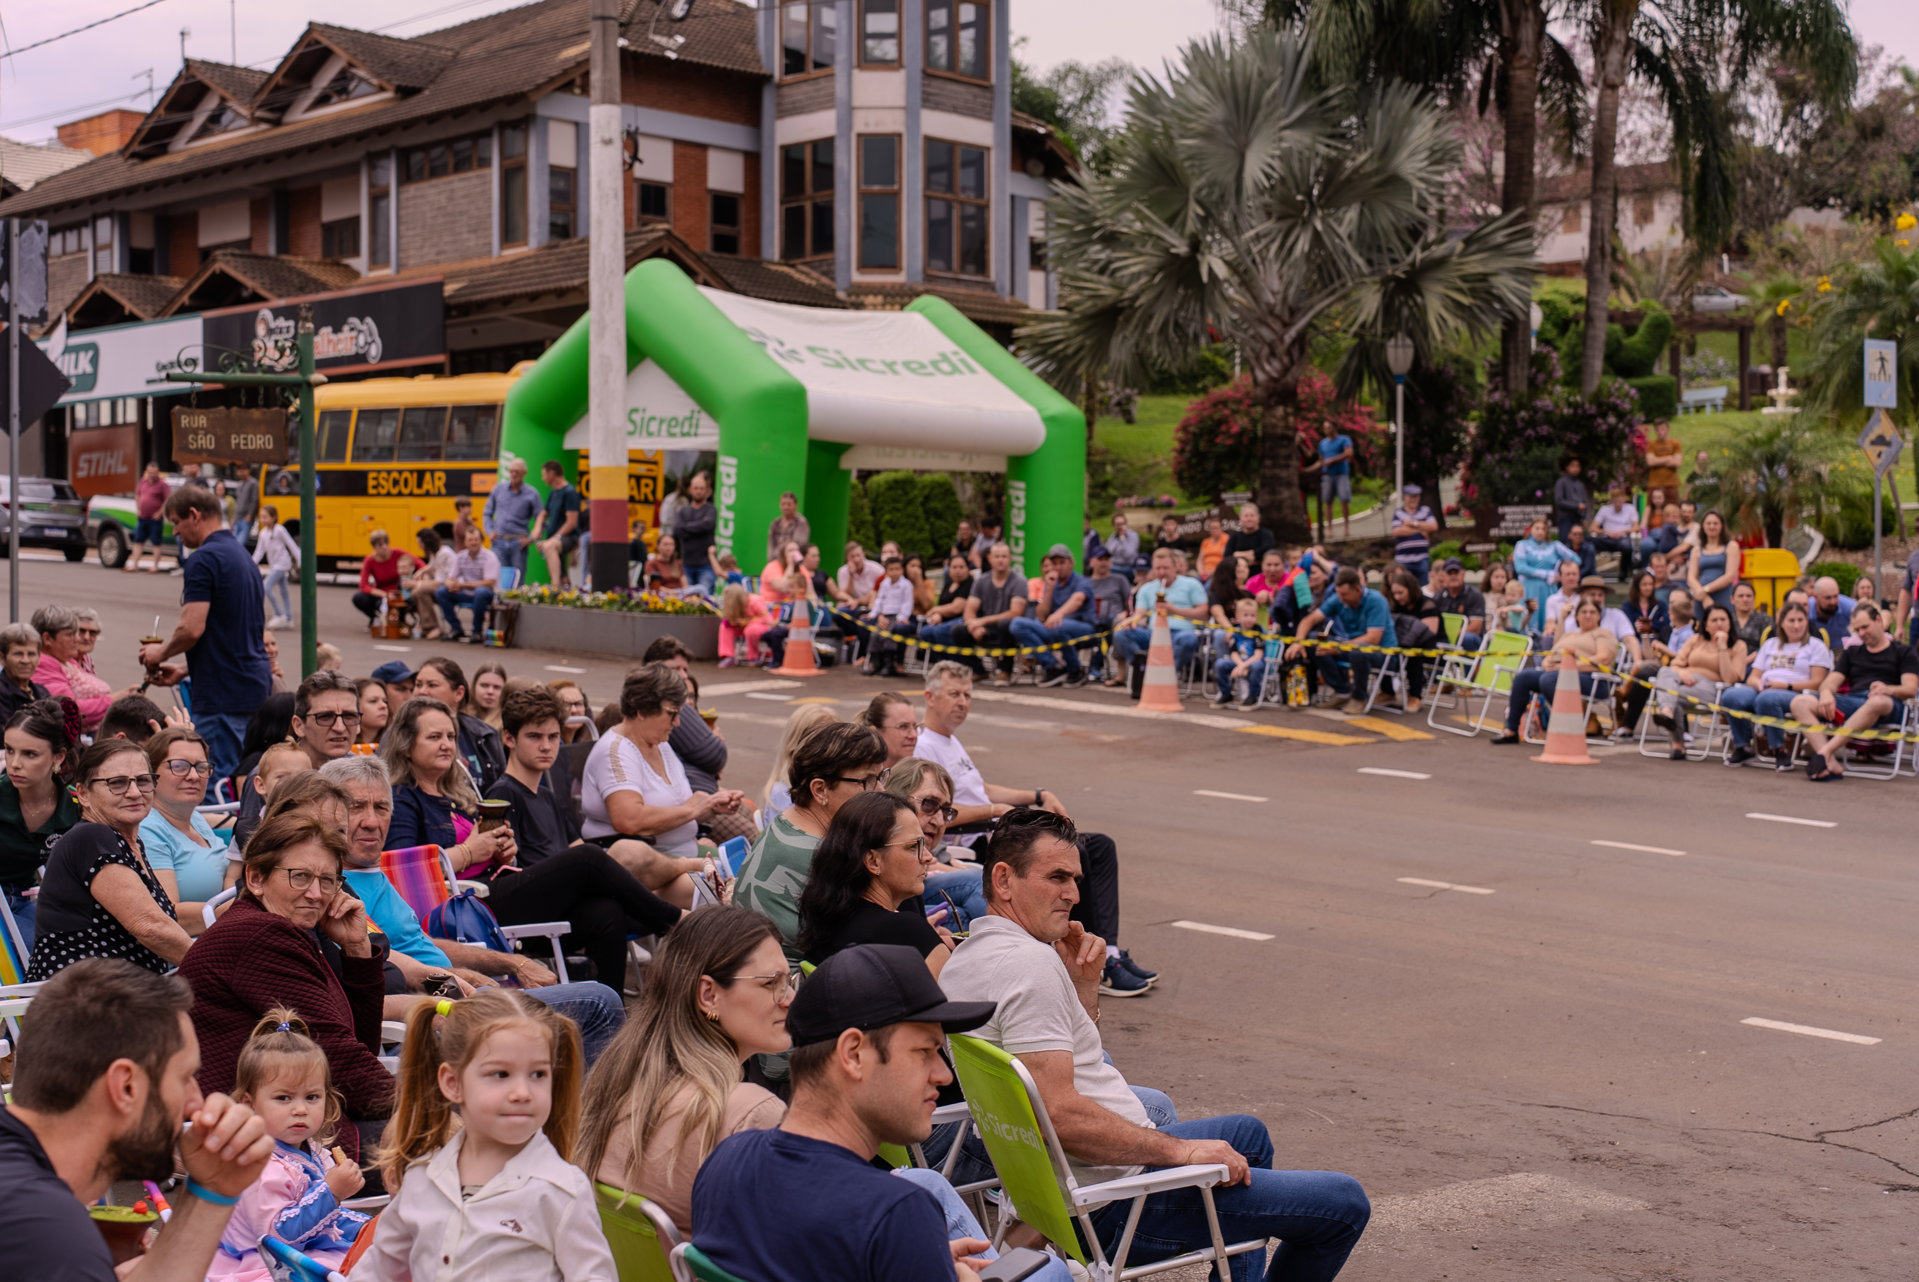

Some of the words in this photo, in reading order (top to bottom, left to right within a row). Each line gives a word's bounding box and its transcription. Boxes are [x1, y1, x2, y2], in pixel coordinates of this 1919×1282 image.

[805, 345, 979, 377] Sicredi
[181, 414, 207, 428] RUA
[626, 407, 702, 437] Sicredi
[188, 431, 215, 449] SÃO
[230, 434, 273, 449] PEDRO
[76, 451, 129, 478] STIHL
[367, 471, 447, 495] ESCOLAR
[987, 1112, 1041, 1152] Sicredi
